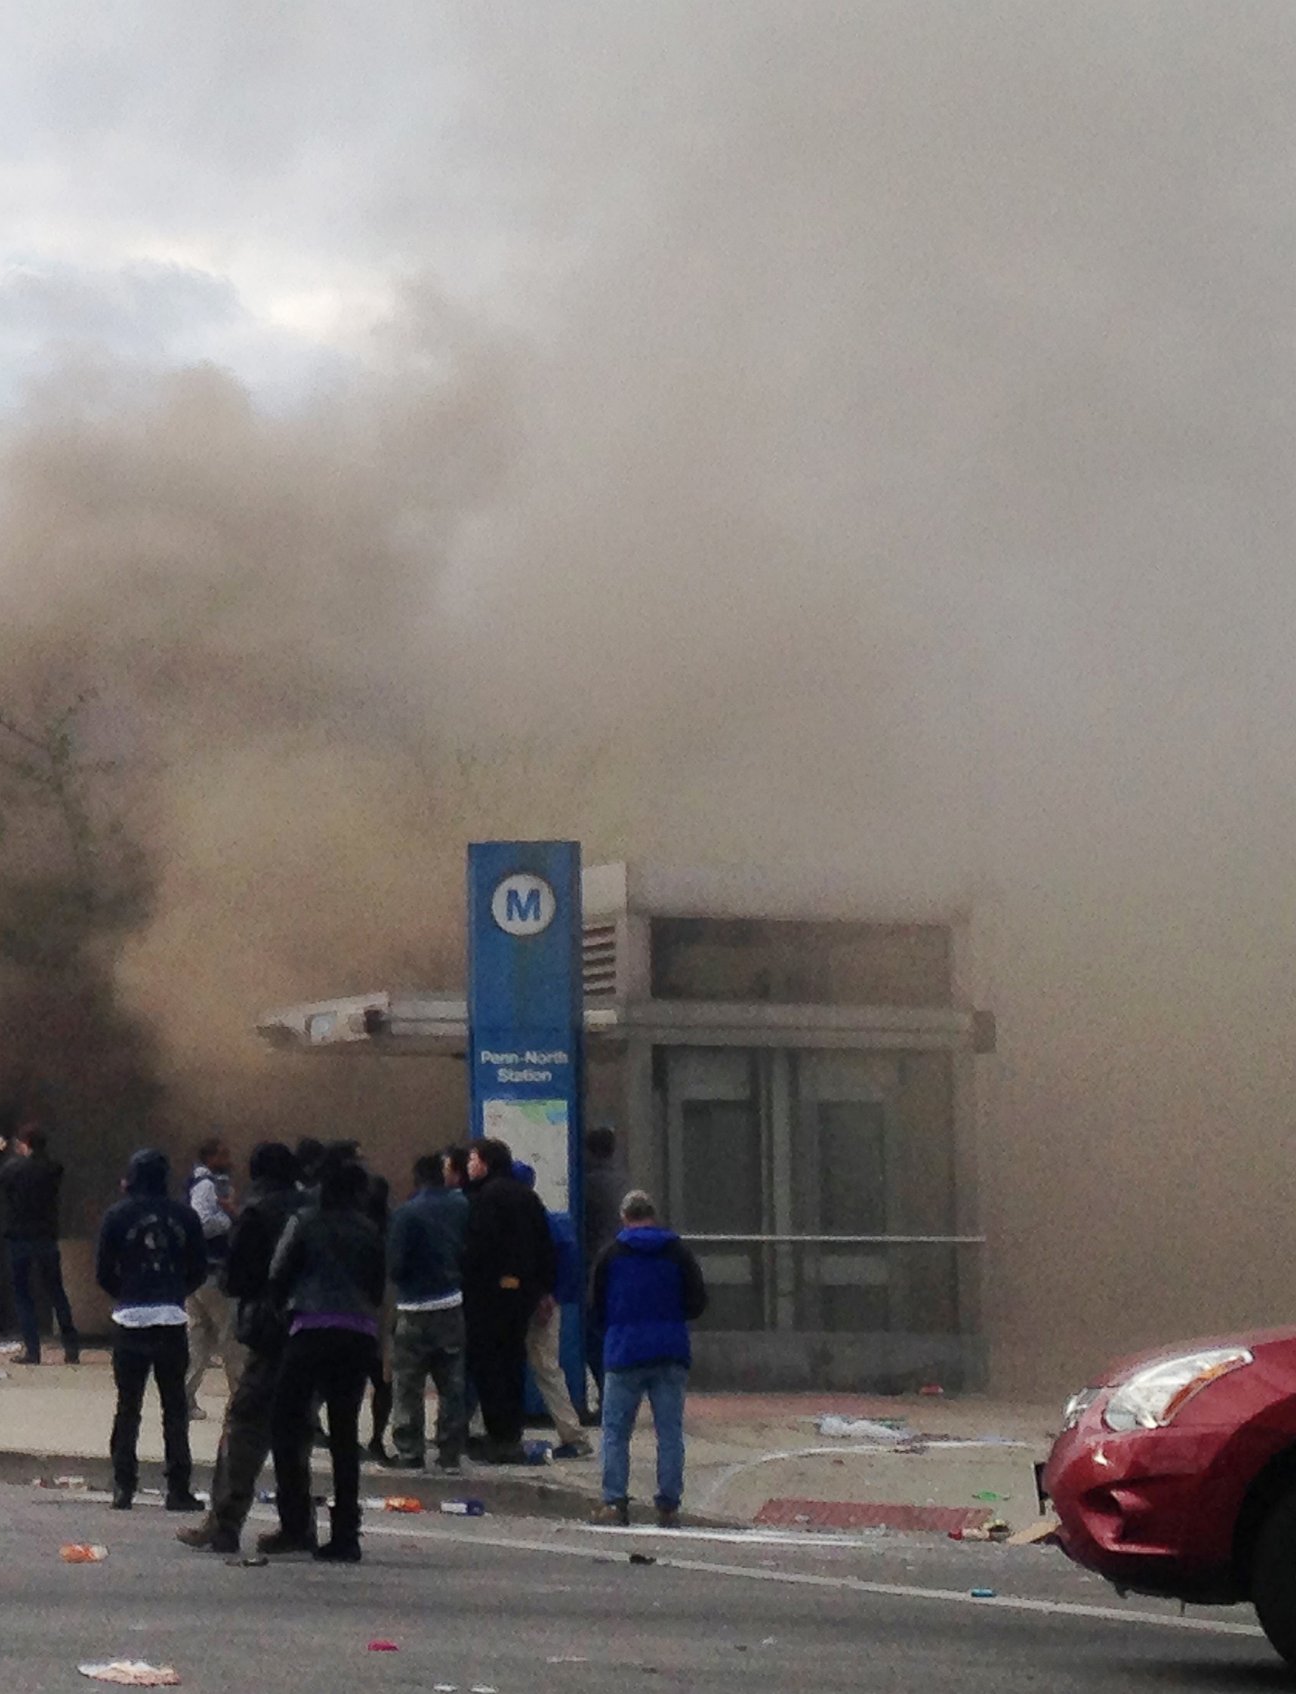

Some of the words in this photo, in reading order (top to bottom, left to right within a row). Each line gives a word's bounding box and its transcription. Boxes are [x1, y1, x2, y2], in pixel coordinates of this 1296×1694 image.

[506, 888, 541, 922] M
[480, 1050, 569, 1065] Penn-North
[496, 1067, 553, 1083] Station
